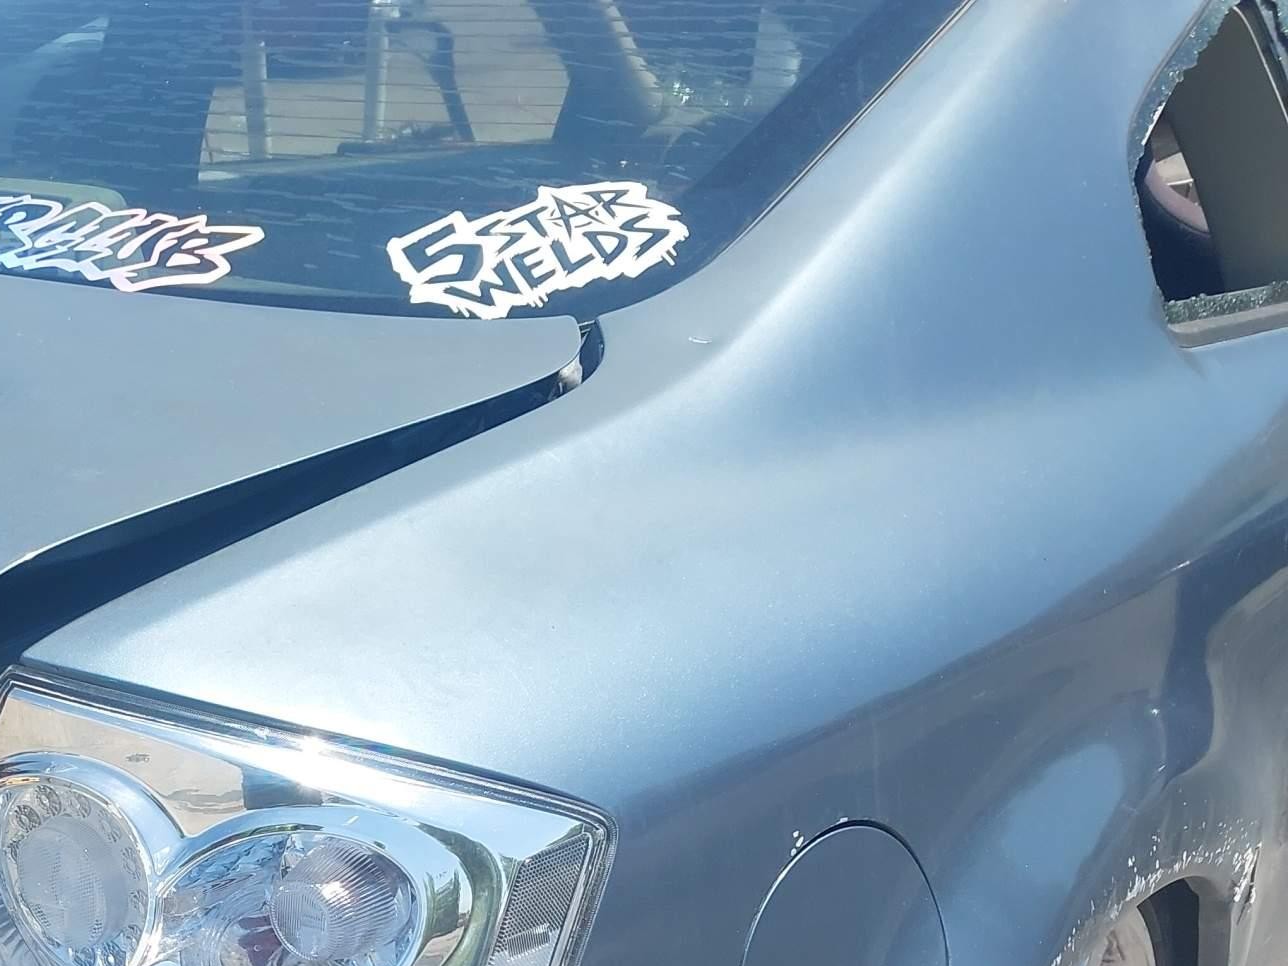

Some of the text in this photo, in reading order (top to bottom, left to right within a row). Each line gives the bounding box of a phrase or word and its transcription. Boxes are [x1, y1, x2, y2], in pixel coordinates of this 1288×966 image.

[401, 188, 658, 285] 5 STAR
[443, 213, 672, 307] WELDS
